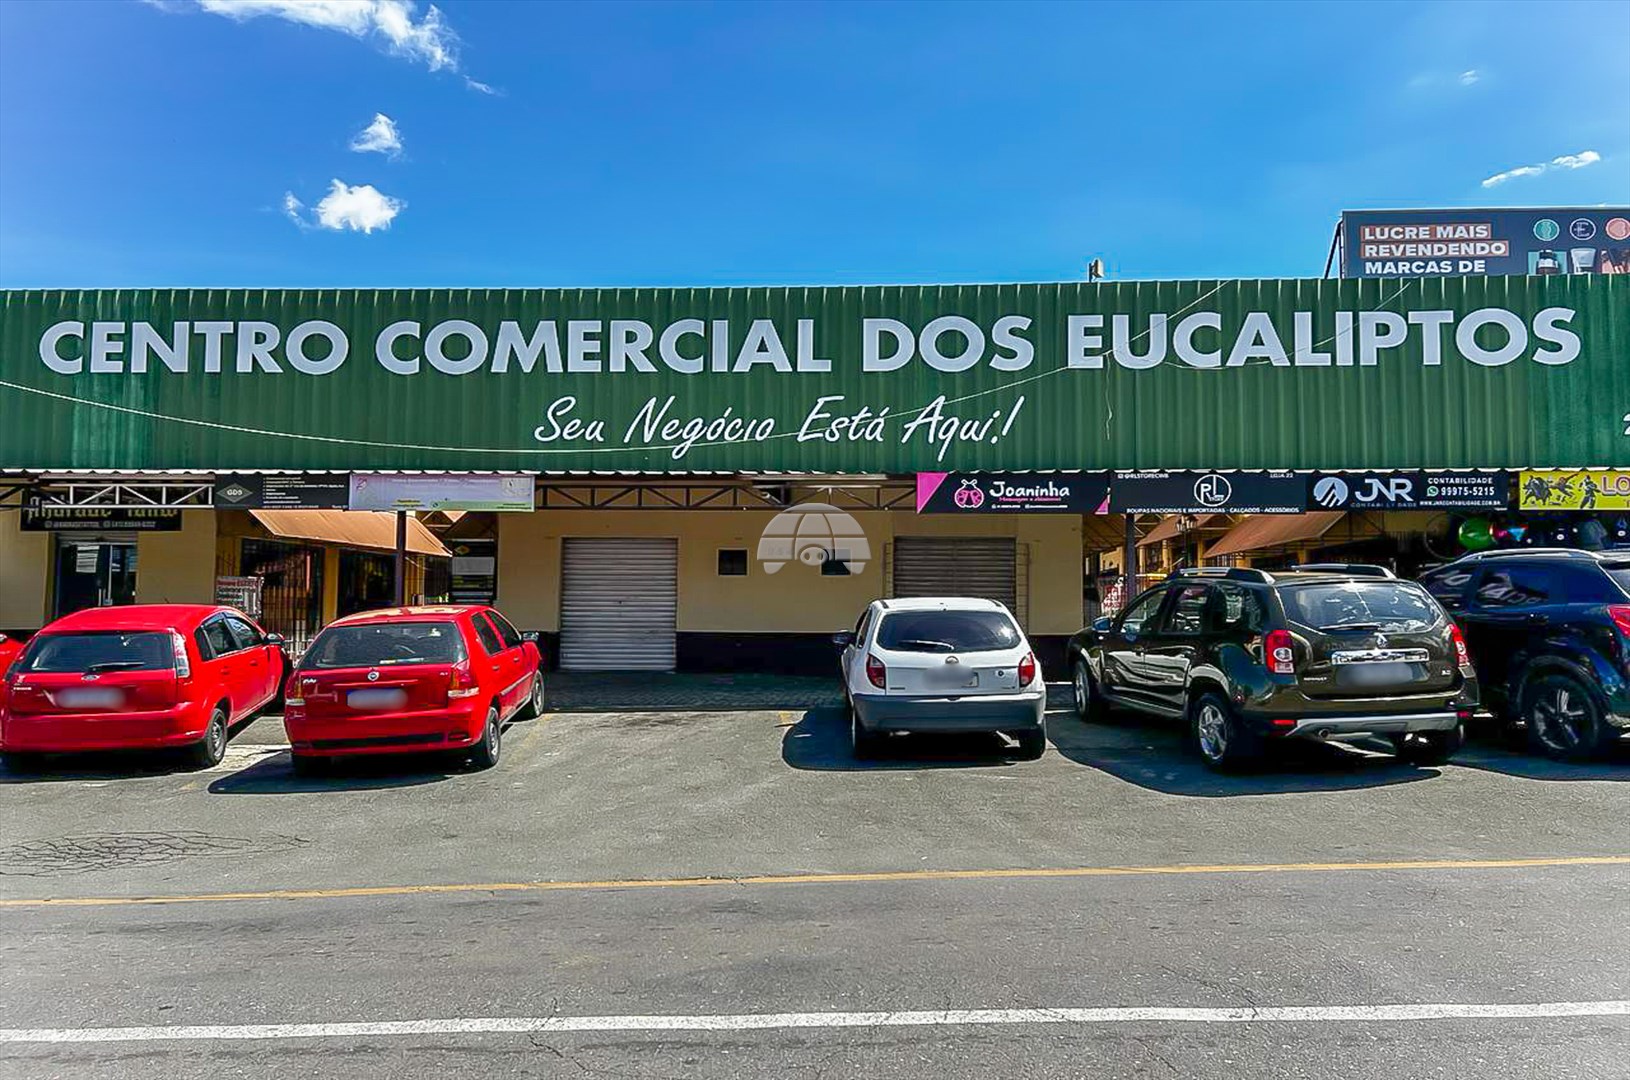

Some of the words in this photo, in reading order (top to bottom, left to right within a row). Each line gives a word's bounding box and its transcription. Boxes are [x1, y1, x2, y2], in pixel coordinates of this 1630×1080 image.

[1364, 226, 1430, 241] LUCRE
[1436, 225, 1488, 239] MAIS
[1364, 241, 1506, 258] REVENDENDO
[1365, 260, 1453, 275] MARCAS
[1458, 259, 1486, 274] DE
[39, 319, 349, 376] CENTRO
[375, 318, 832, 375] COMERCIAL
[862, 315, 1035, 373] DOS
[1066, 307, 1581, 371] EUCALIPTOS
[534, 395, 604, 442] Seu
[623, 395, 776, 460] Negócio
[796, 395, 890, 442] Está
[900, 394, 1026, 462] Aqui!
[989, 480, 1070, 498] Joaninha
[1354, 478, 1414, 502] JNR
[1440, 486, 1495, 496] 99975-5215
